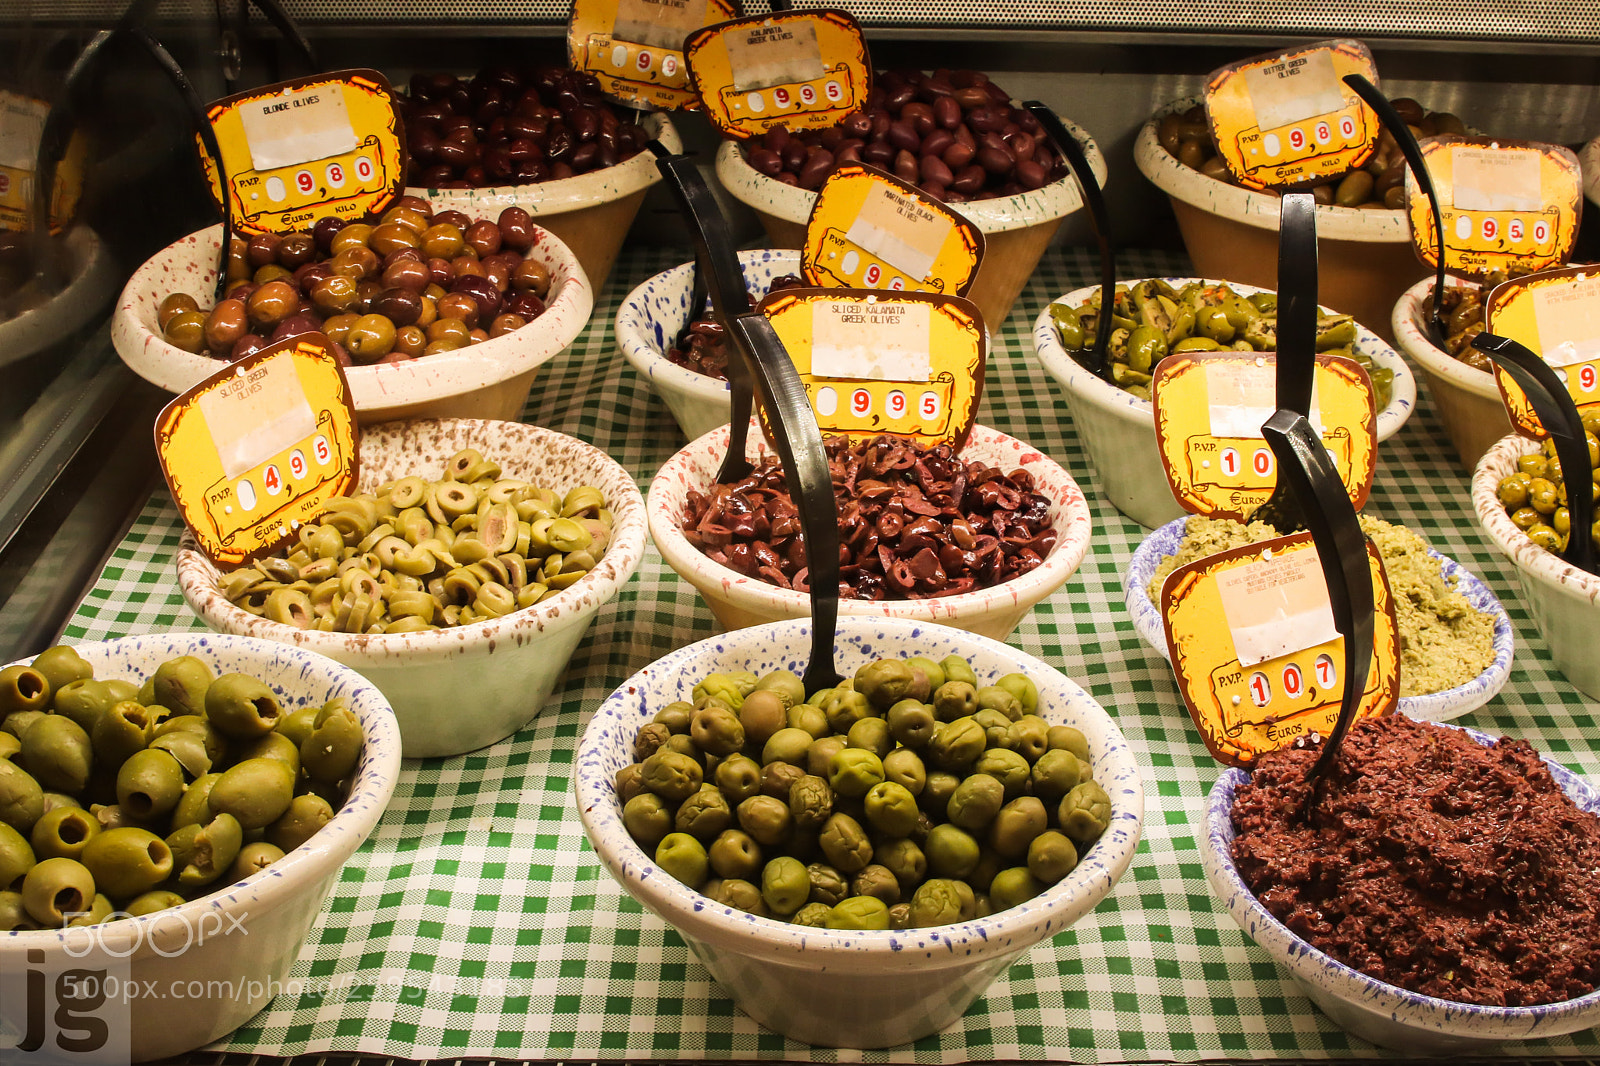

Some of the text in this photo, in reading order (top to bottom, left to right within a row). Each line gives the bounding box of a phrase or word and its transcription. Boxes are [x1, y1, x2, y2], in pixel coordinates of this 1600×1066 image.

[750, 26, 783, 37] KALAMATA
[747, 32, 793, 45] GREEK OLIVES
[1263, 58, 1308, 76] BITTER GREEN
[1277, 67, 1301, 80] OLIVES
[656, 91, 675, 100] KILO
[263, 95, 320, 115] BLONDE OLIVES
[808, 115, 828, 123] KILO
[1322, 157, 1341, 168] KILO
[335, 203, 357, 214] KILO
[883, 189, 936, 223] MARINATED BLACK
[896, 206, 918, 223] OLIVES
[832, 305, 905, 315] SLICED KALAMATA
[841, 314, 900, 324] GREEK OLIVES
[220, 366, 269, 399] SLICED GREEN
[238, 383, 262, 401] OLIVES
[300, 496, 320, 513] KILO
